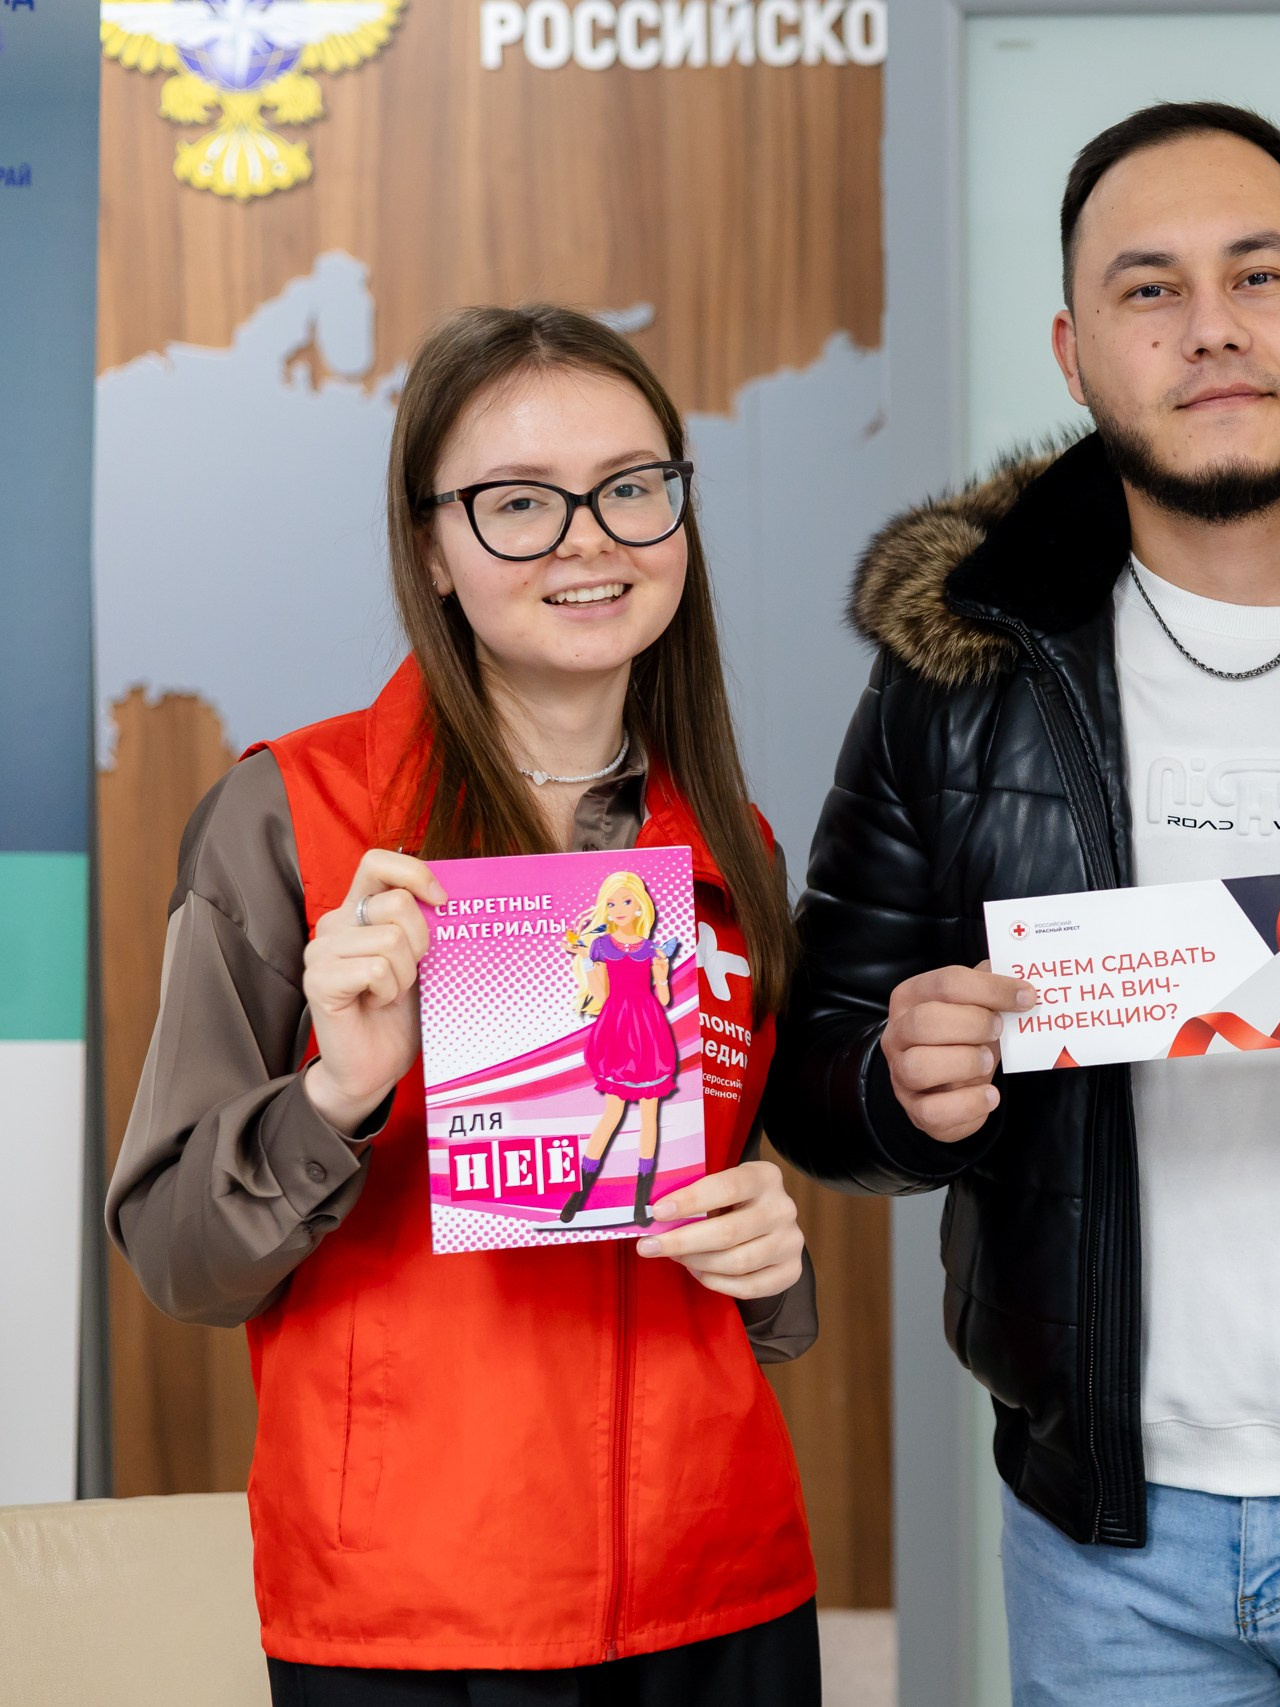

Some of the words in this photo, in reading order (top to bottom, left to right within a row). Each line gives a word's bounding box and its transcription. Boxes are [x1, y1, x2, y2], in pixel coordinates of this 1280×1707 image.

[480, 0, 889, 70] РОССИЙСКО
[1167, 815, 1234, 830] ROAD
[435, 894, 552, 917] СЕКРЕТНЫЕ
[436, 918, 566, 941] МАТЕРИАЛЫ
[1035, 926, 1062, 934] КРАСНЫЙ
[1011, 957, 1094, 980] ЗАЧЕМ
[1101, 946, 1216, 974] СДАВАТЬ
[1035, 986, 1072, 1006] ЕСТ
[1080, 982, 1114, 1002] НА
[1121, 976, 1180, 997] ВИЧ-
[1018, 1003, 1178, 1034] ИНФЕКЦИЮ?
[449, 1111, 503, 1138] ДЛЯ
[454, 1139, 577, 1192] НЕЁ
